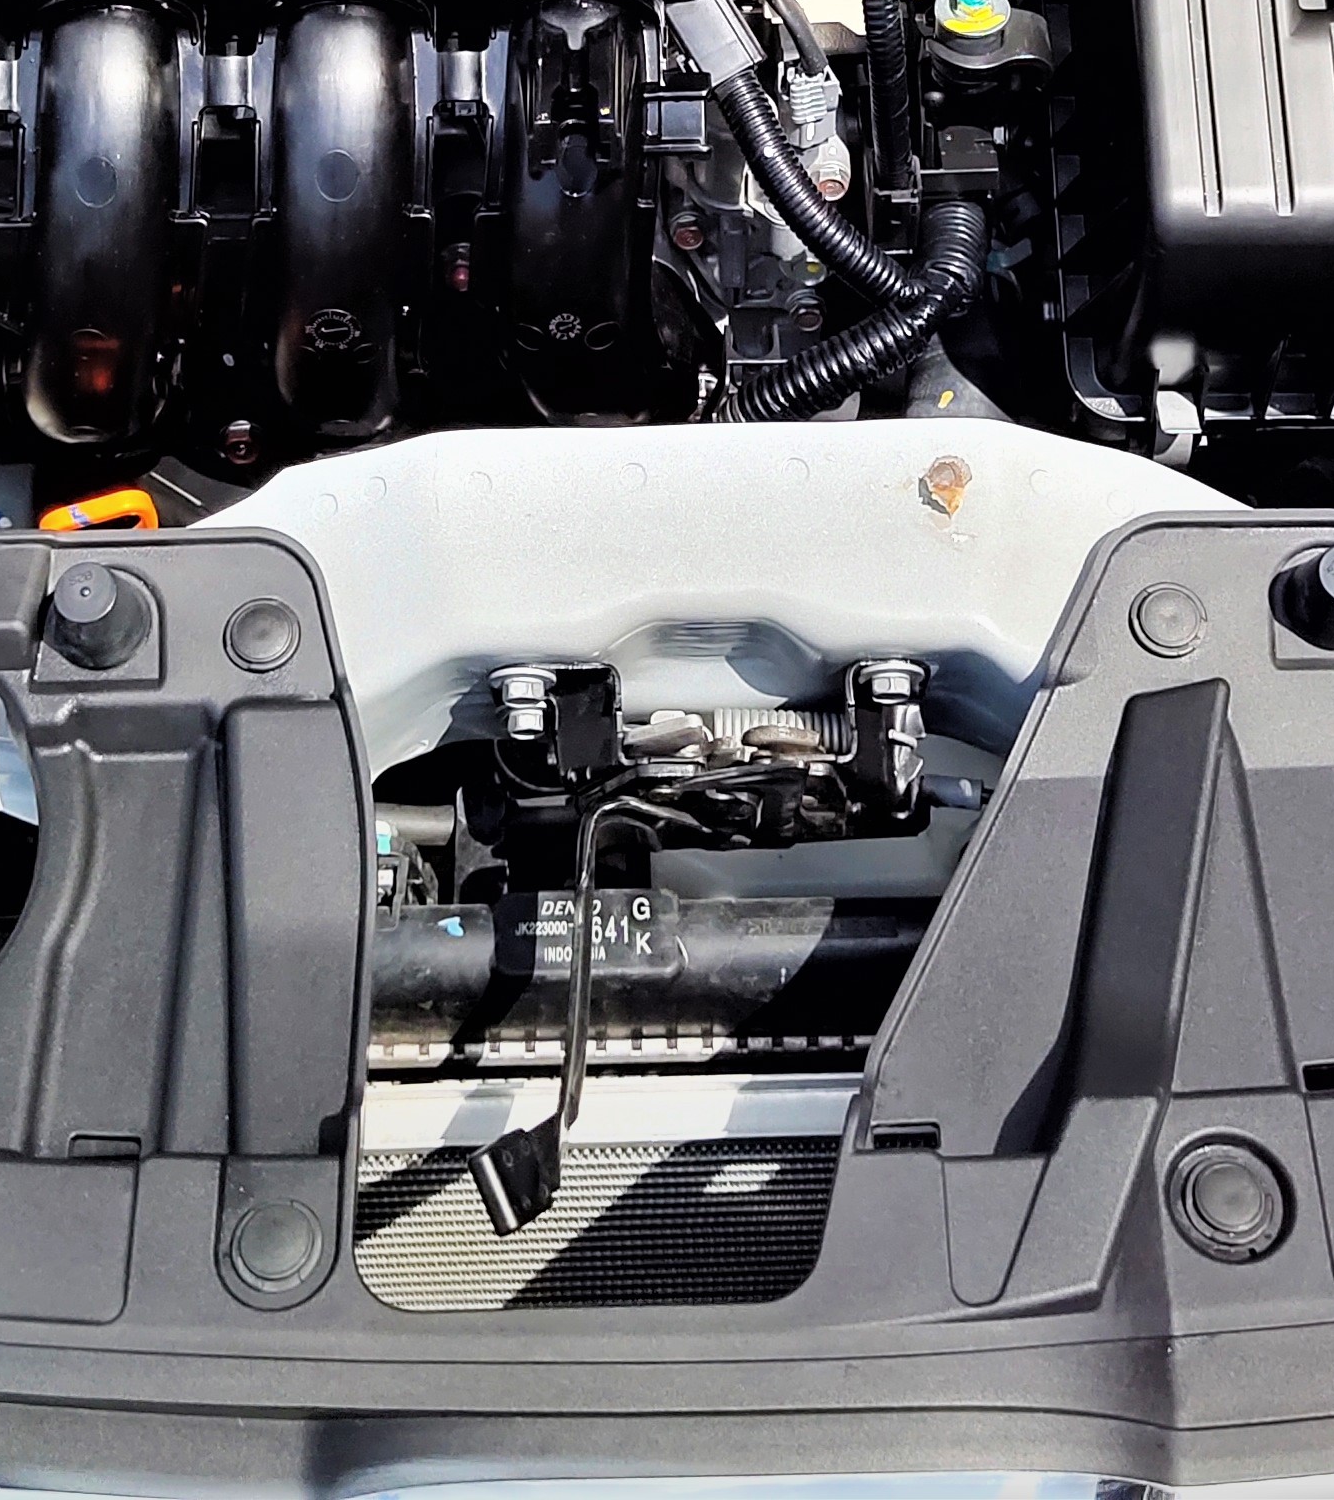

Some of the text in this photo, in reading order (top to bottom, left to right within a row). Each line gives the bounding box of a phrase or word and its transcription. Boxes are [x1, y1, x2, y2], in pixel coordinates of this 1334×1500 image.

[540, 896, 652, 922] DENO G
[543, 945, 607, 965] INDOIA
[635, 931, 653, 956] K
